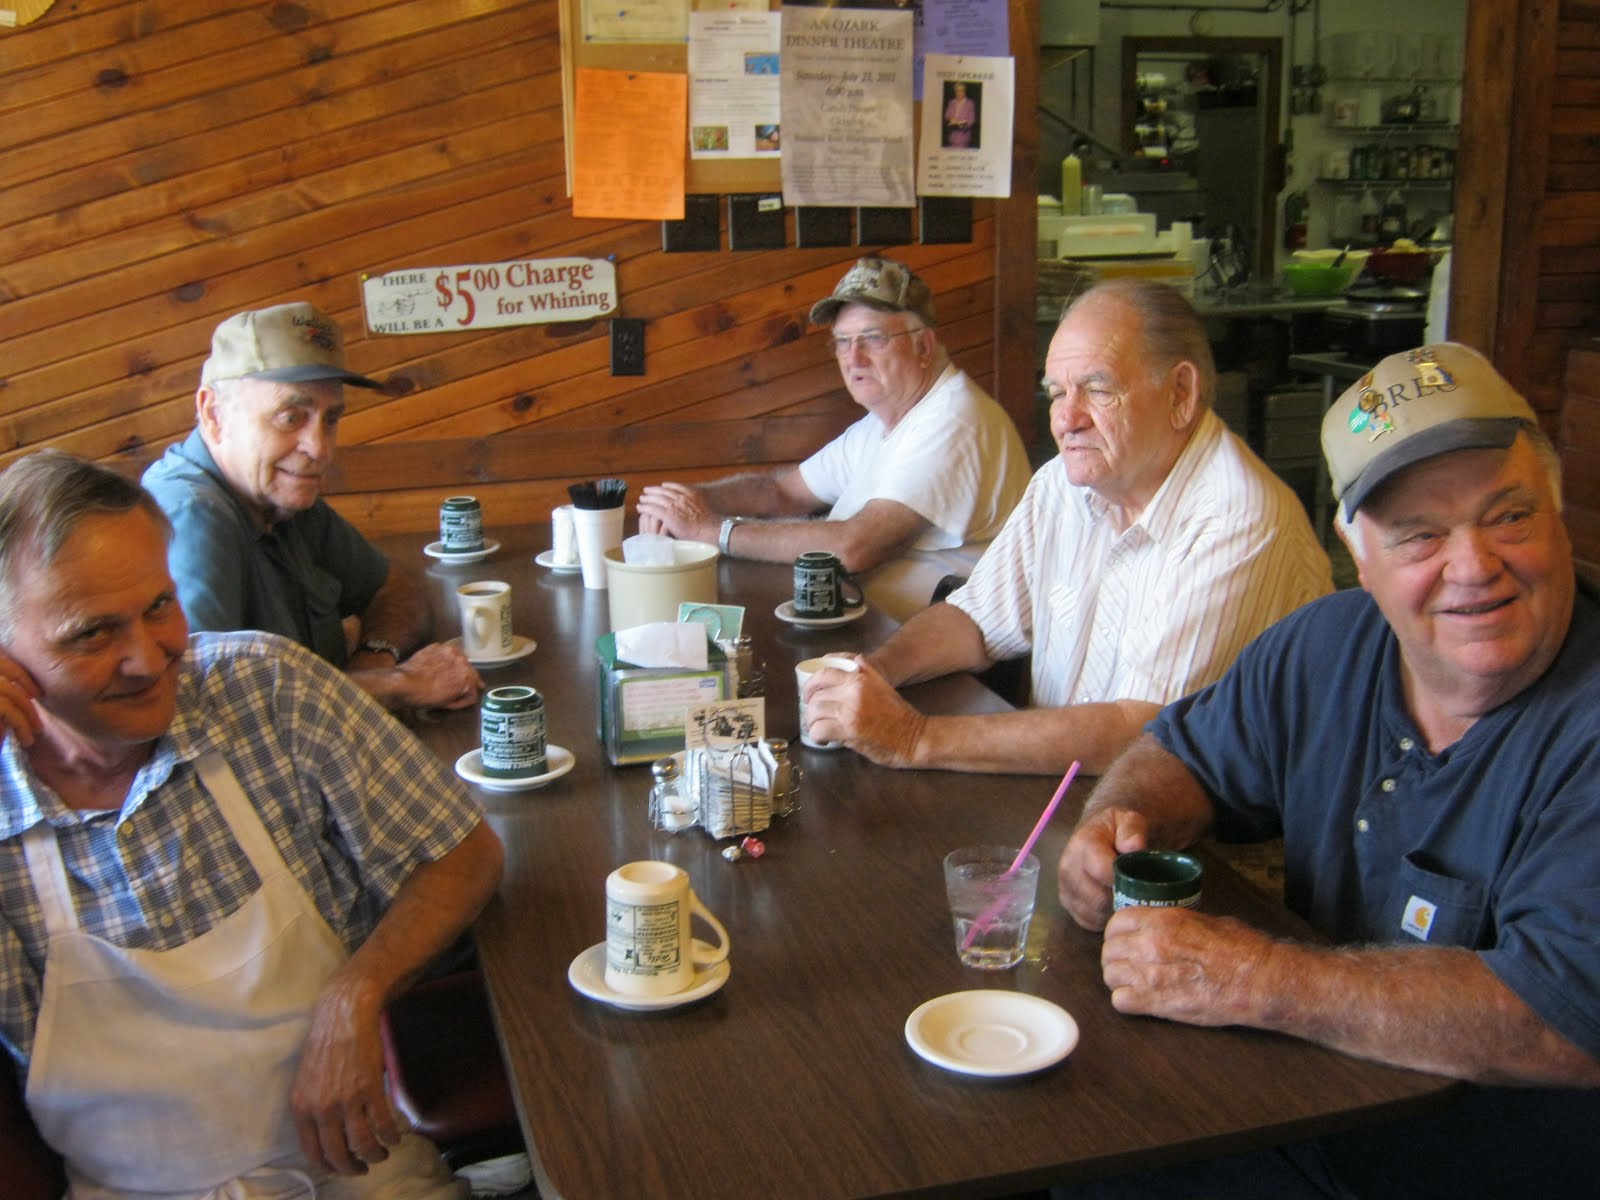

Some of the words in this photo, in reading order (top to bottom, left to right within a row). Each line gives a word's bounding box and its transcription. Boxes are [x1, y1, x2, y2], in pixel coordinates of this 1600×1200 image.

[832, 20, 880, 32] OZARK
[785, 35, 840, 48] DINNER
[844, 37, 904, 50] THEATRE
[381, 273, 427, 287] THERE
[506, 262, 595, 290] Charge
[497, 297, 522, 316] for
[529, 290, 609, 312] Whining
[373, 319, 410, 335] WILL
[413, 319, 431, 332] BE
[433, 317, 445, 329] A
